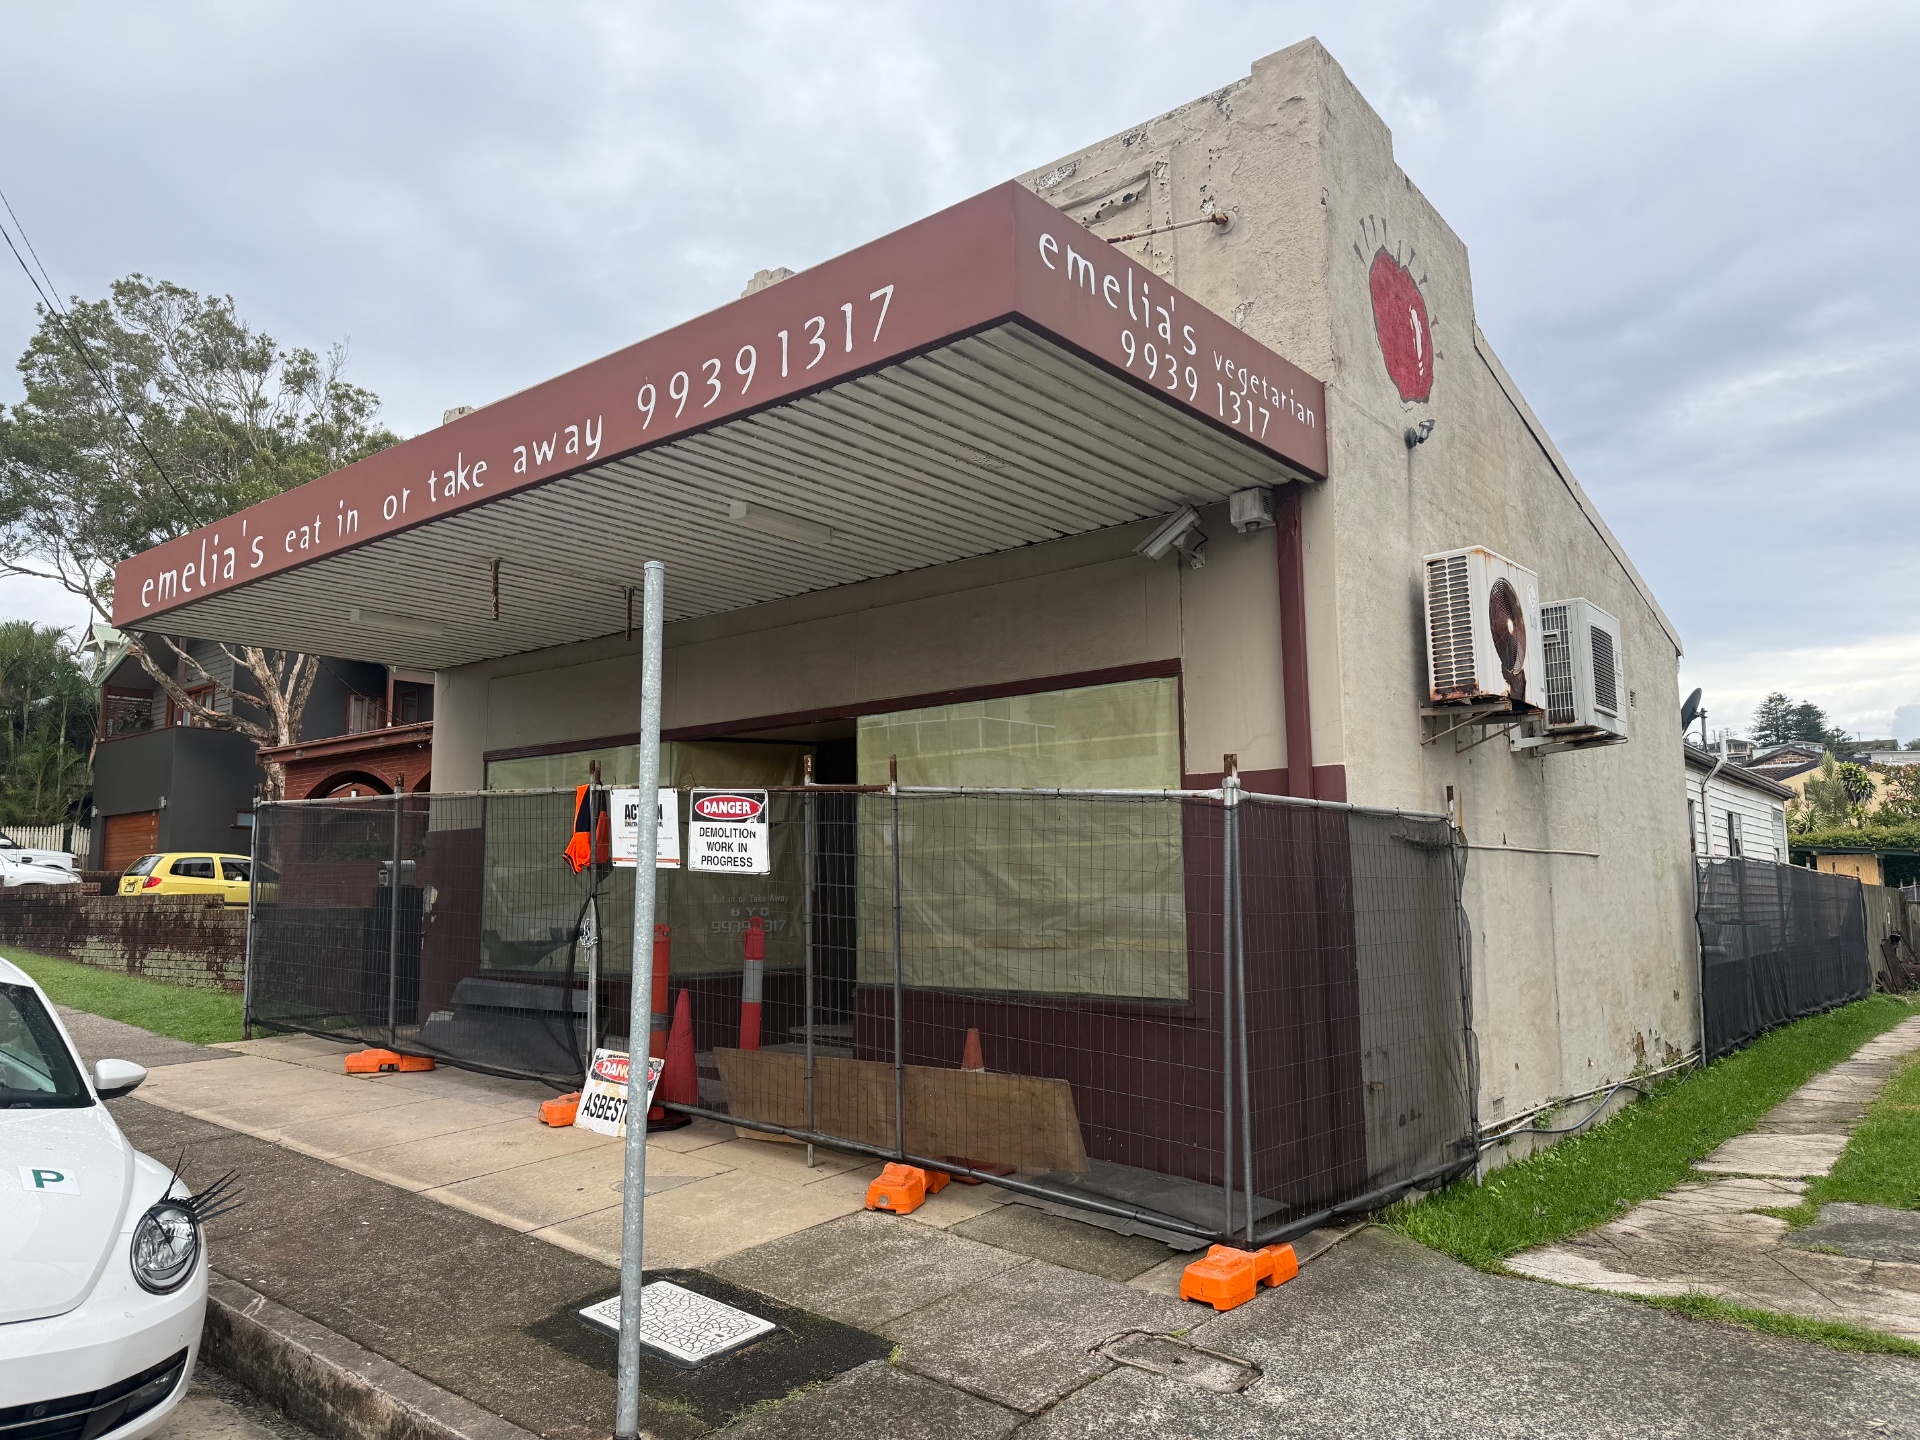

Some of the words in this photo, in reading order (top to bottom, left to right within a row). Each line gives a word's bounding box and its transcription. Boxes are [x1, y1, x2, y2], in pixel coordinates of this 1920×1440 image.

[1038, 233, 1197, 356] emelia's
[1213, 350, 1316, 429] vegetarian
[1121, 329, 1198, 402] 9939
[1216, 382, 1270, 439] 1317
[141, 519, 264, 608] emelia's
[285, 514, 322, 554] eat
[337, 499, 359, 539] in
[383, 487, 411, 521] or
[428, 451, 488, 503] take
[513, 414, 603, 475] away
[703, 801, 751, 814] DANGER
[699, 827, 756, 839] DEMOLITION
[706, 841, 734, 852] WORK
[738, 842, 748, 853] IN
[701, 855, 753, 868] PROGRESS
[712, 894, 725, 904] Eat
[729, 894, 736, 903] in
[738, 895, 746, 903] or
[749, 894, 767, 903] Take
[769, 893, 789, 904] Away
[582, 1092, 628, 1124] ASBEST
[31, 1169, 65, 1188] P
